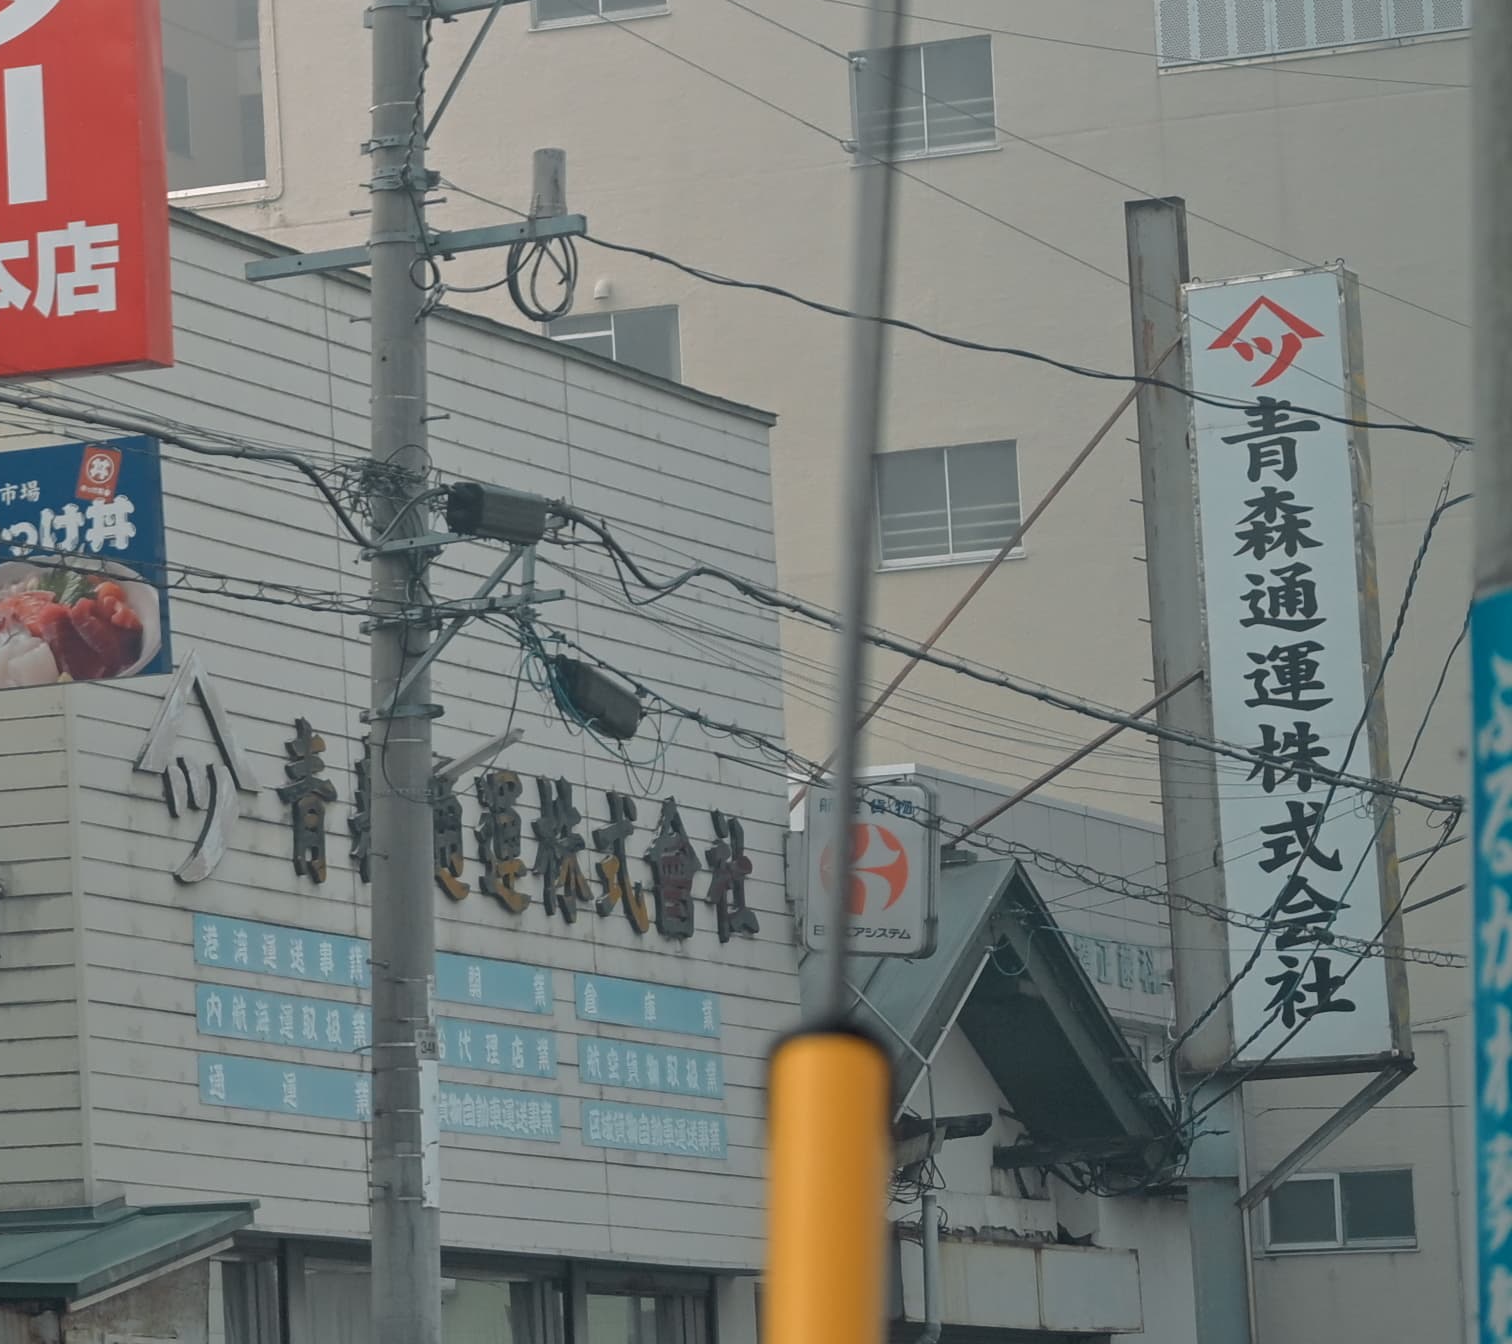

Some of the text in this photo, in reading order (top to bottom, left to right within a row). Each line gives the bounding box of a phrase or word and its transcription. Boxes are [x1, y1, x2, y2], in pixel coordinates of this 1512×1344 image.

[1221, 396, 1355, 1029] 青森通運株式会社
